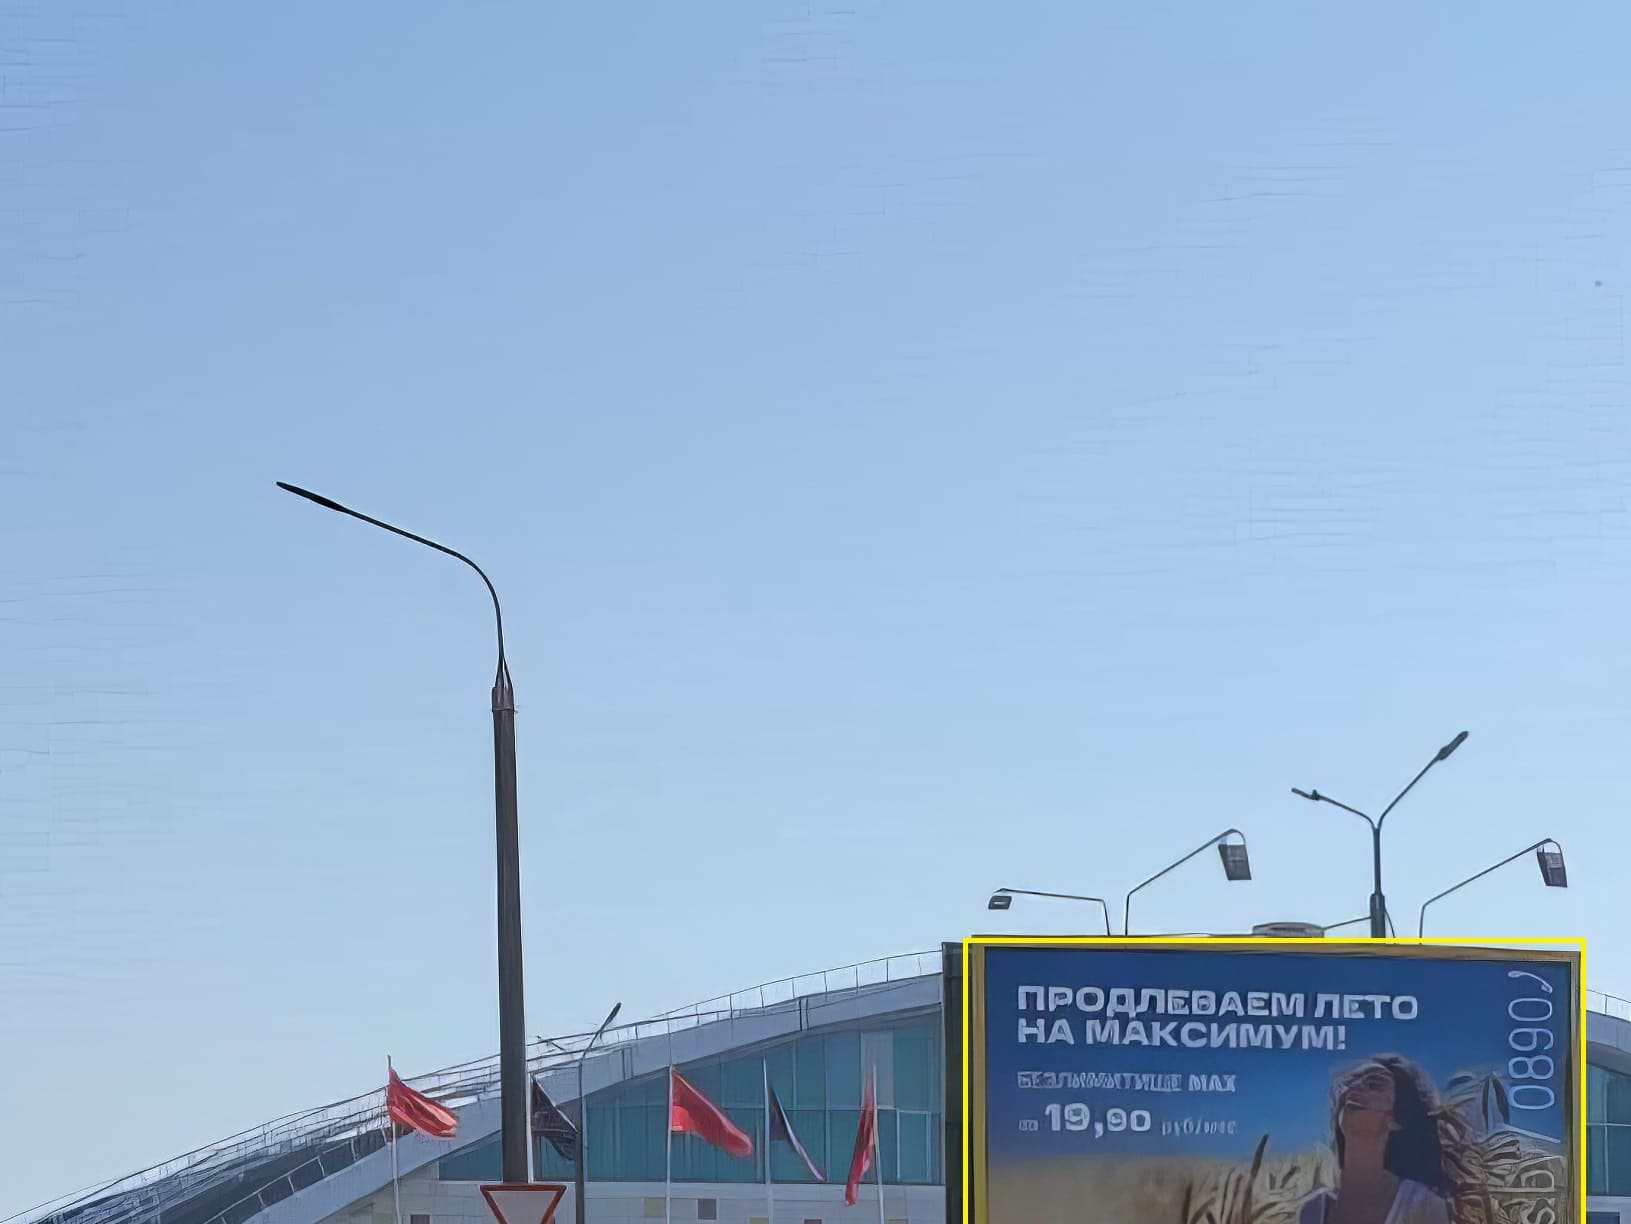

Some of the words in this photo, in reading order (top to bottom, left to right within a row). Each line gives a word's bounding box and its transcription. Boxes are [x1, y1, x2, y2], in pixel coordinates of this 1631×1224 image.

[1017, 984, 1305, 1018] ПРОДЛЕВАЕМ
[1314, 993, 1419, 1020] ЛЕТО
[1017, 1017, 1075, 1044] НА
[1085, 1019, 1346, 1050] МАКСИМУМ!
[1044, 1102, 1152, 1139] 19,90
